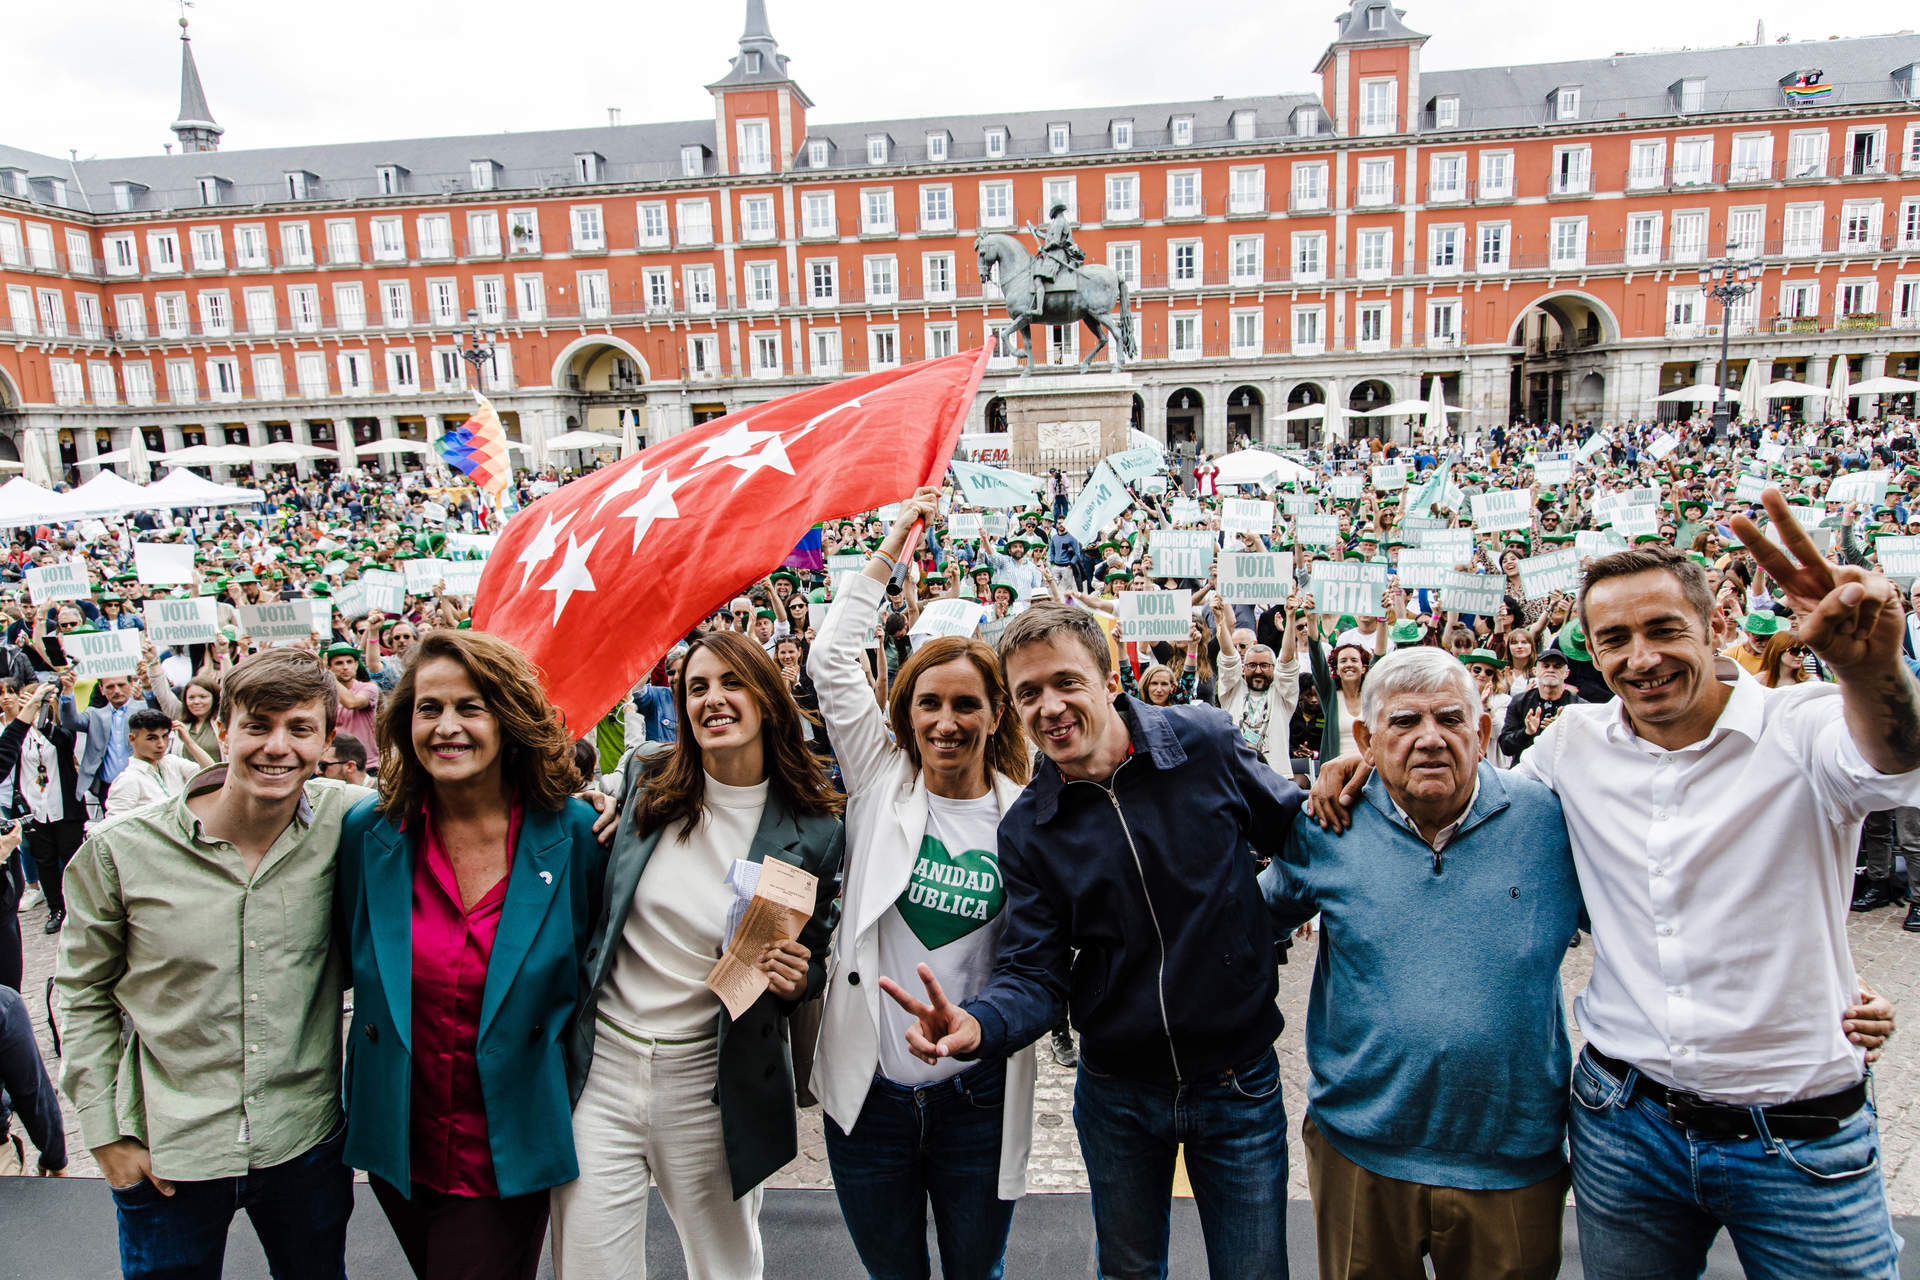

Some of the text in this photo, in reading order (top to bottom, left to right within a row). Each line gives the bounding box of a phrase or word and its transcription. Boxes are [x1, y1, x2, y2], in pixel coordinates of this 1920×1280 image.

[1235, 502, 1261, 517] VOTA
[1484, 493, 1517, 511] VOTA
[1151, 531, 1212, 548] MADRID CON
[1159, 547, 1201, 577] RITA
[1235, 556, 1276, 578] VOTA
[40, 565, 73, 583] VOTA
[1314, 563, 1385, 583] MADRID CON
[1399, 565, 1444, 585] MÓNIC
[1445, 571, 1504, 590] MADRID CON
[1220, 581, 1289, 599] LO PRÓXIMO
[1323, 581, 1372, 614] RITA
[1136, 594, 1175, 616] VOTA
[1441, 587, 1501, 614] MÓNICA
[160, 601, 199, 622] VOTA
[257, 604, 296, 622] VOTA
[151, 627, 163, 641] LO
[271, 623, 311, 637] MADRID
[1122, 618, 1189, 636] LO PRÓXIMO
[80, 633, 123, 656] VOTA
[913, 857, 995, 893] ANIDAD
[906, 878, 989, 920] ÚBLICA
